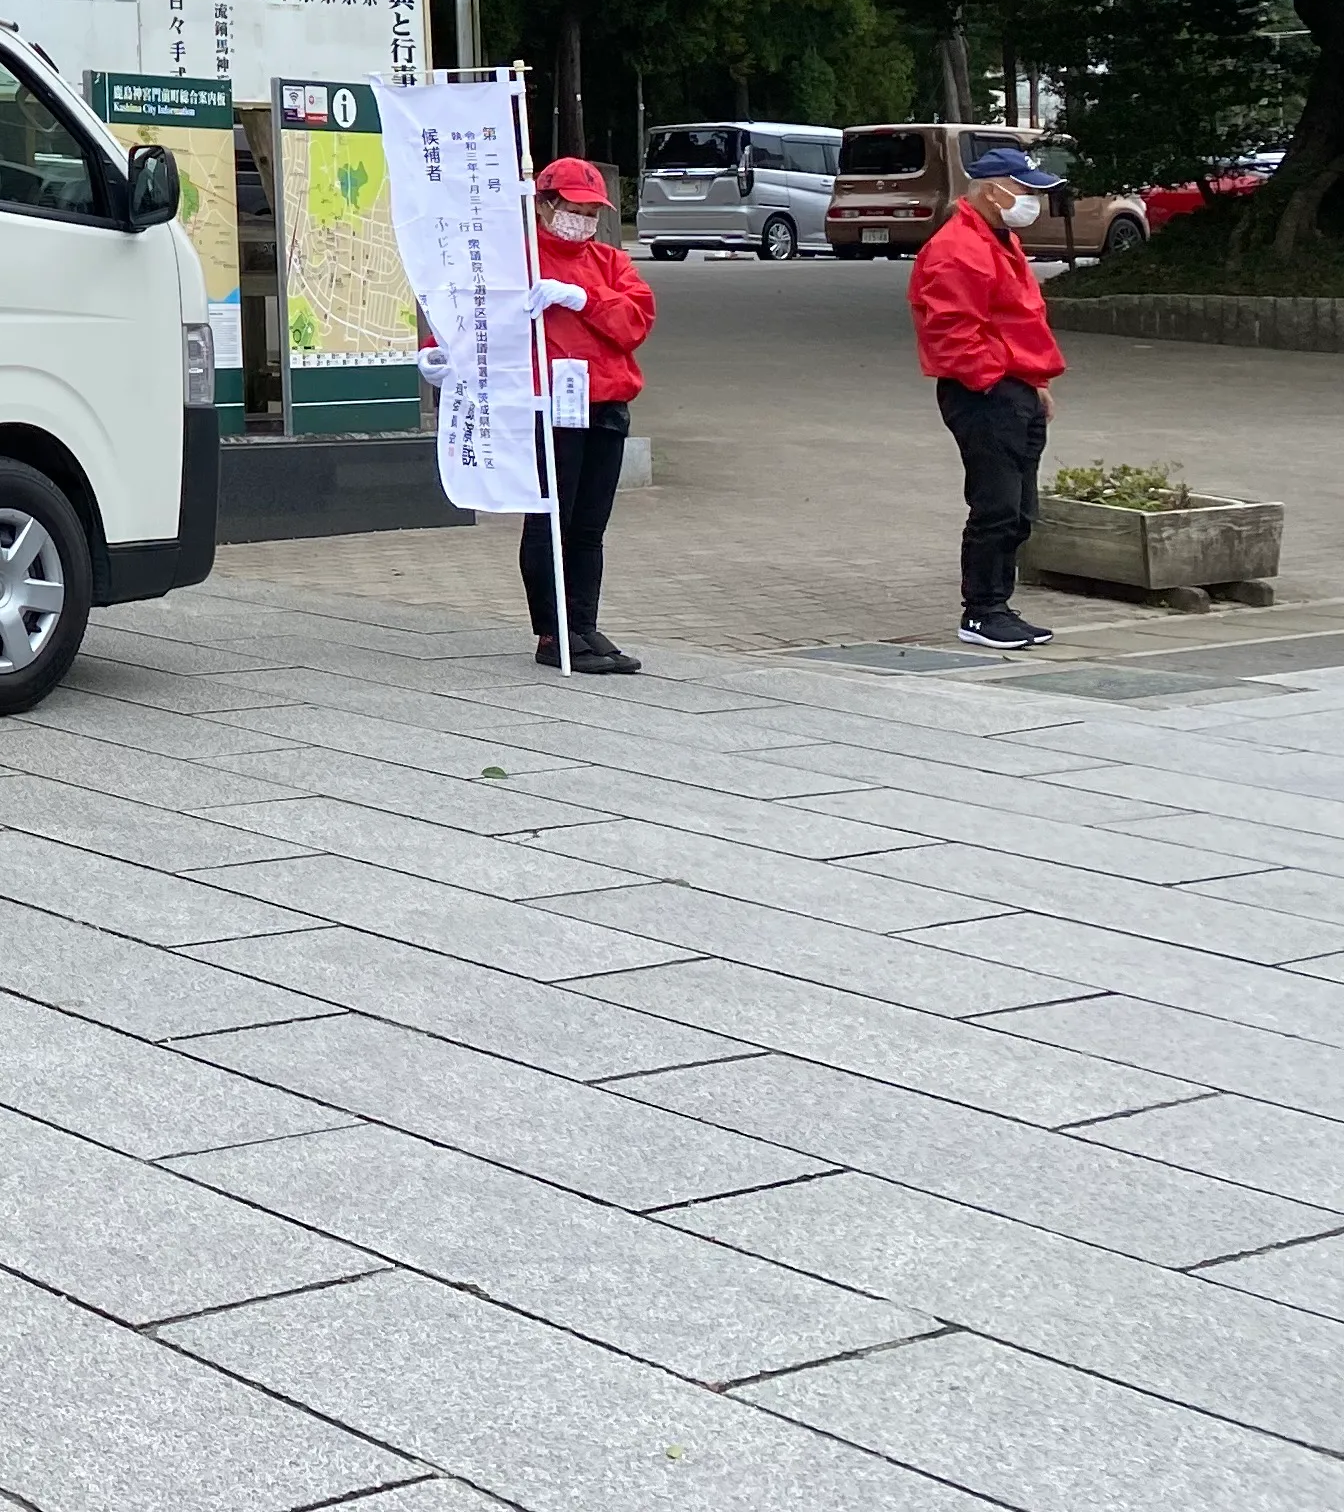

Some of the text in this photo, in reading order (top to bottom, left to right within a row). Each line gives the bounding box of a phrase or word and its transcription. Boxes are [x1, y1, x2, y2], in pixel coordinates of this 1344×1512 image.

[113, 84, 226, 107] 鹿島神宮門前町総合案内板
[113, 101, 196, 117] Kashima City Information
[421, 128, 442, 182] 候補者
[464, 130, 483, 232] 令和三年十月三十一日
[482, 126, 502, 193] 第二号
[434, 216, 466, 332] ふじた 幸久
